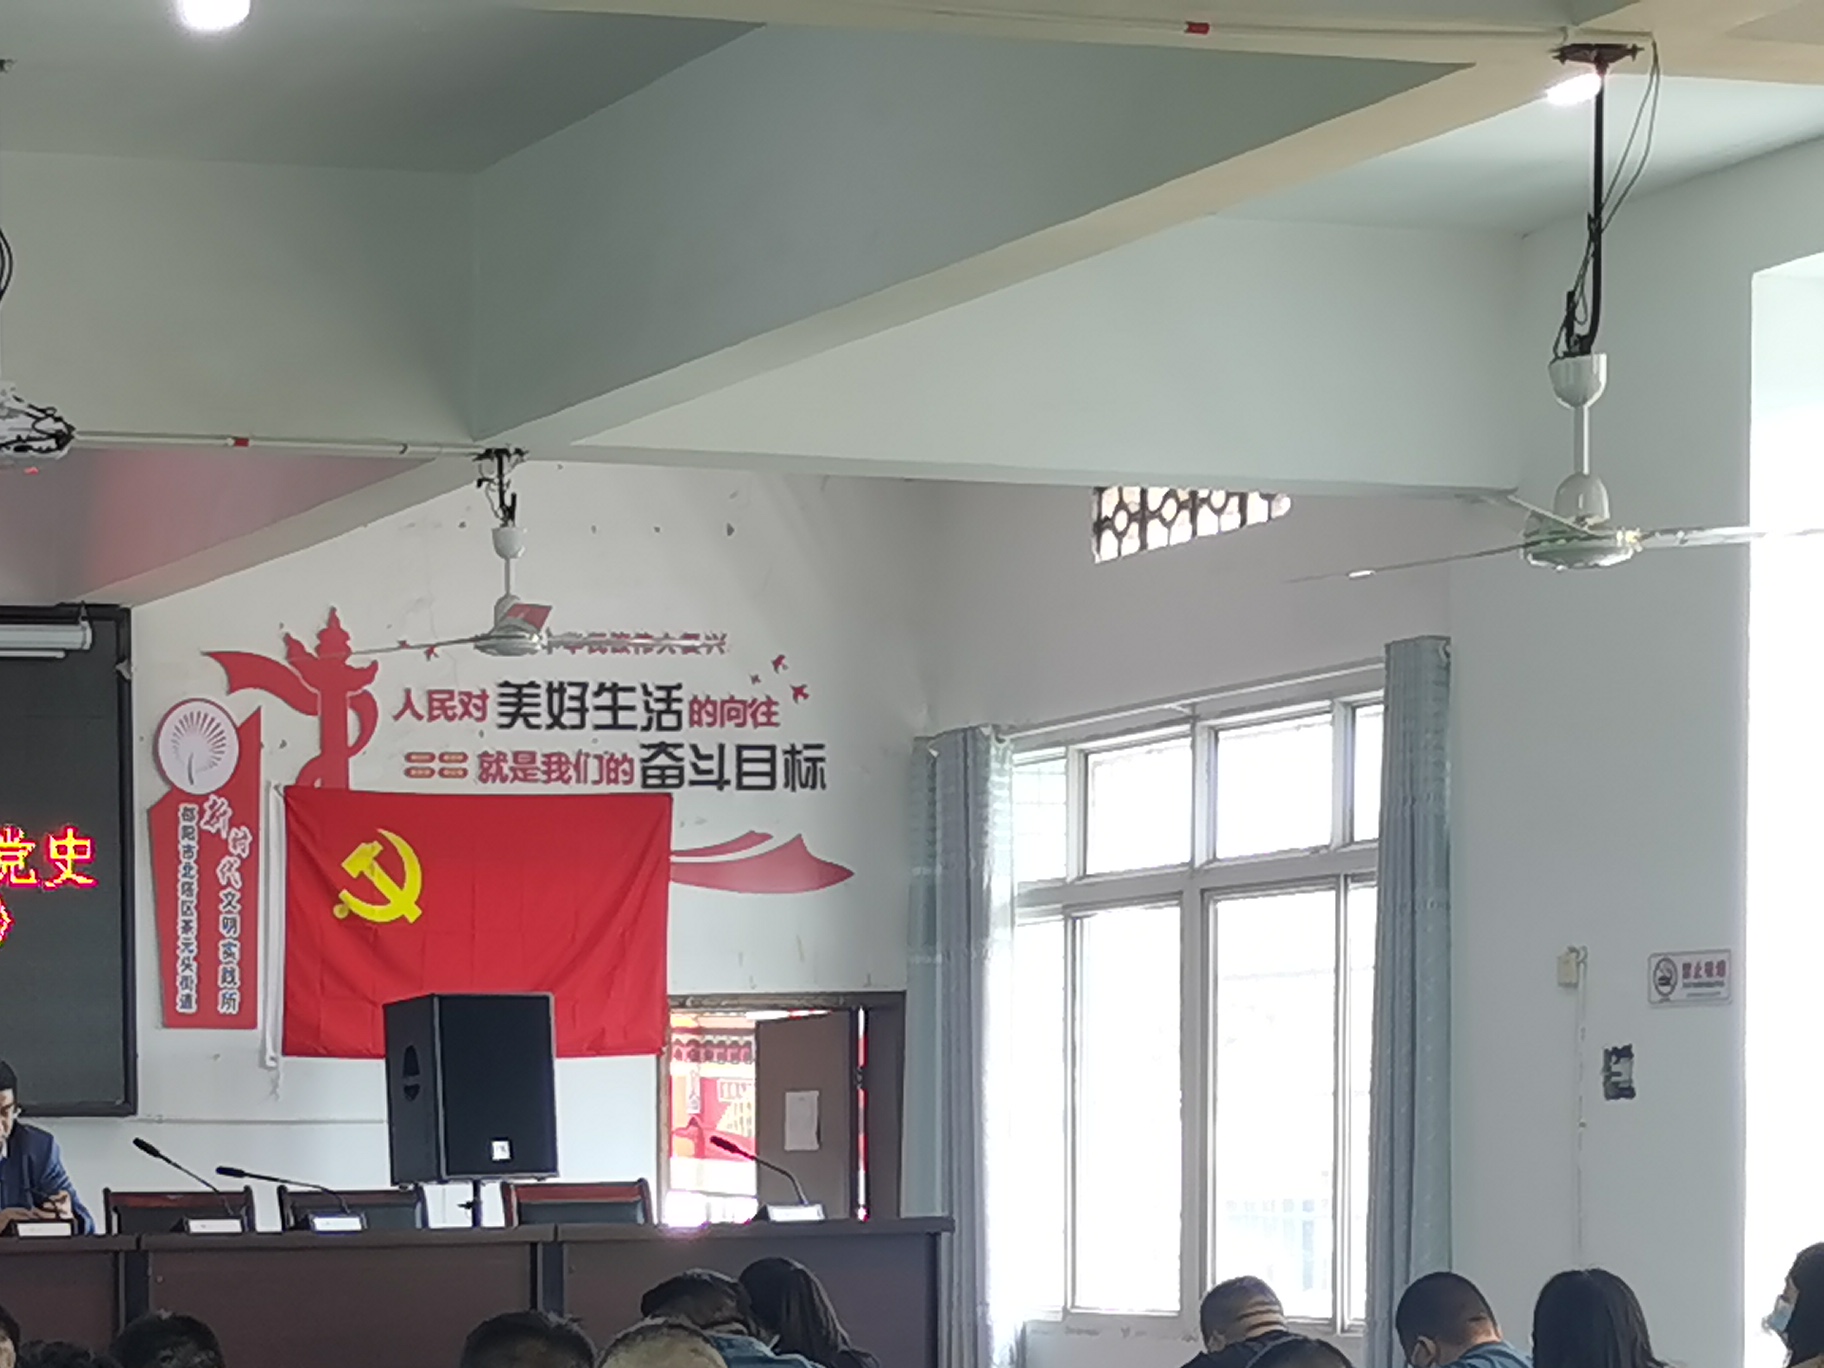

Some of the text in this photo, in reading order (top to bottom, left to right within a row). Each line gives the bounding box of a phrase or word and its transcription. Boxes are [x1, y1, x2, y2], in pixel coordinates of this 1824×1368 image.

[391, 679, 782, 732] 人民对美好生活的向往
[477, 741, 828, 793] 就是我们的奋斗目标
